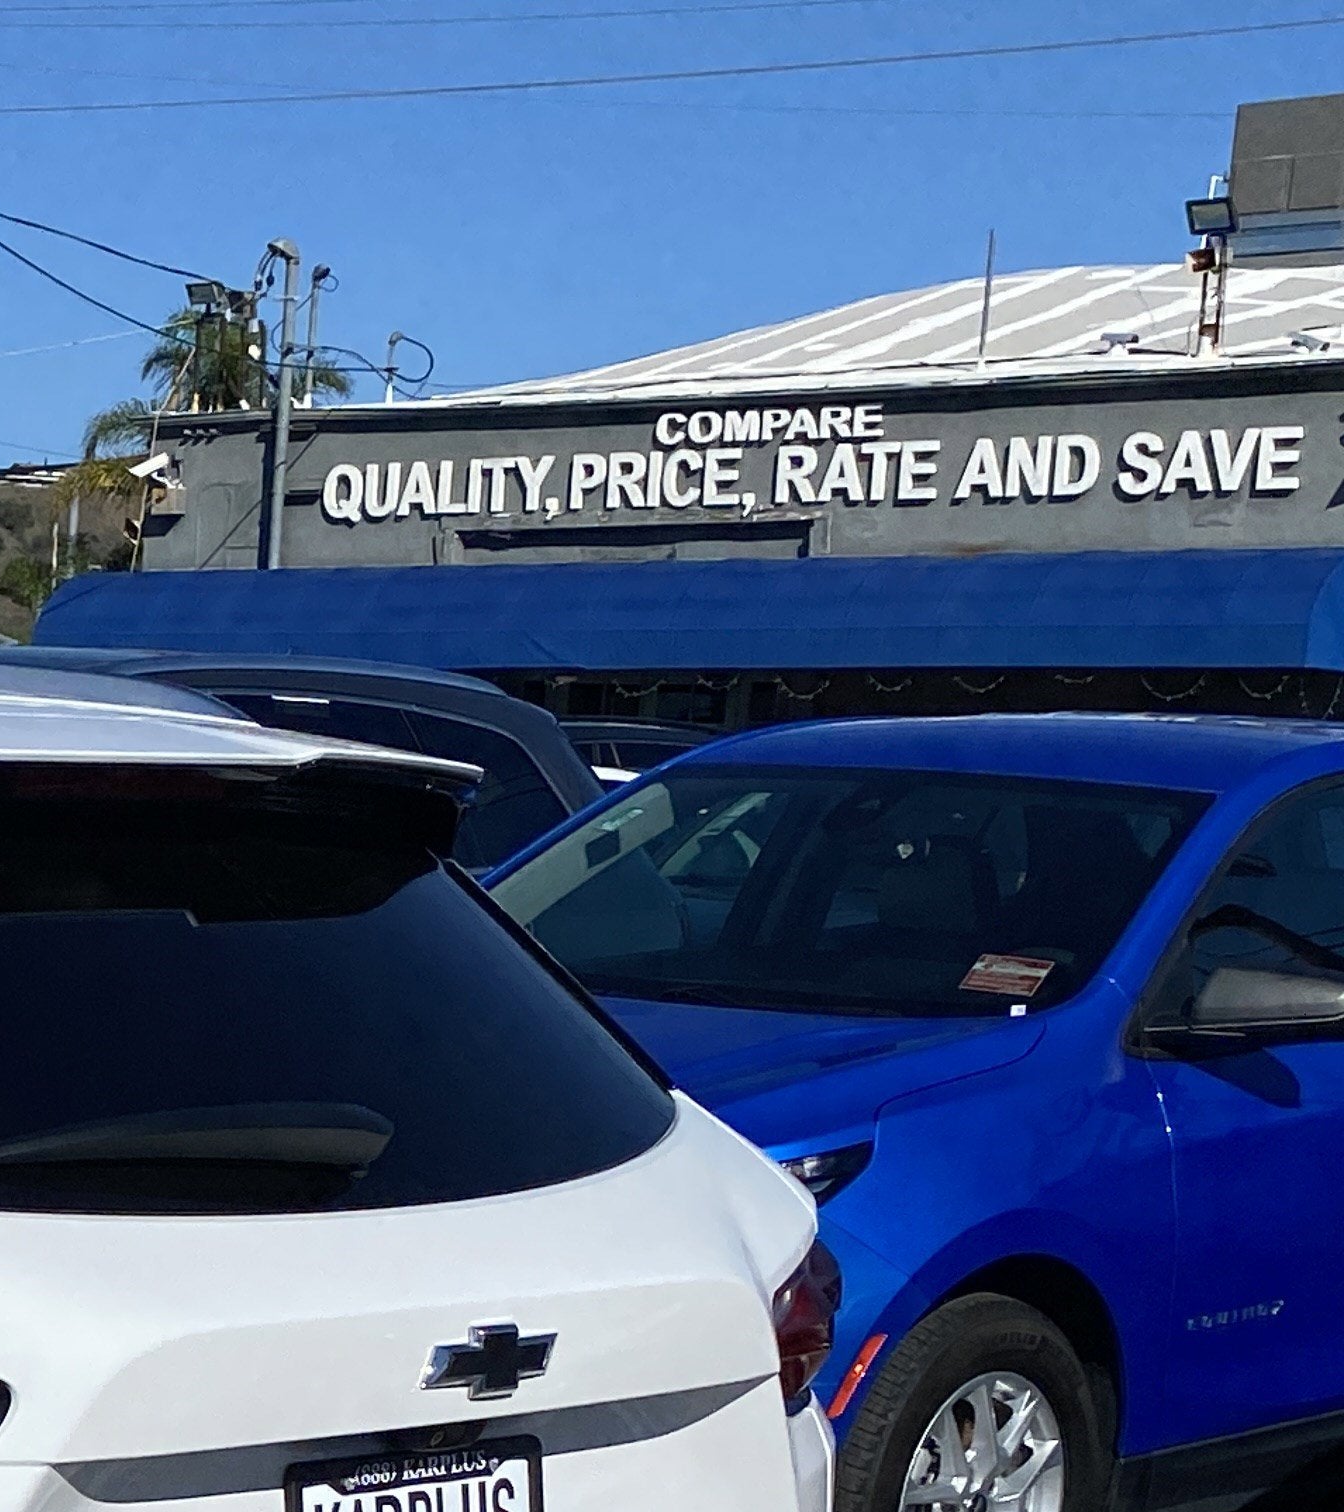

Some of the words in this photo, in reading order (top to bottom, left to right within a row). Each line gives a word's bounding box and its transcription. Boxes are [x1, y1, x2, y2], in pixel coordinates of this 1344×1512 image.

[655, 405, 884, 446] COMPARE
[323, 455, 560, 523] QUALITY,
[569, 448, 756, 517] PRICE,
[775, 440, 941, 502] RATE
[955, 434, 1101, 499] AND
[1117, 426, 1305, 495] SAVE
